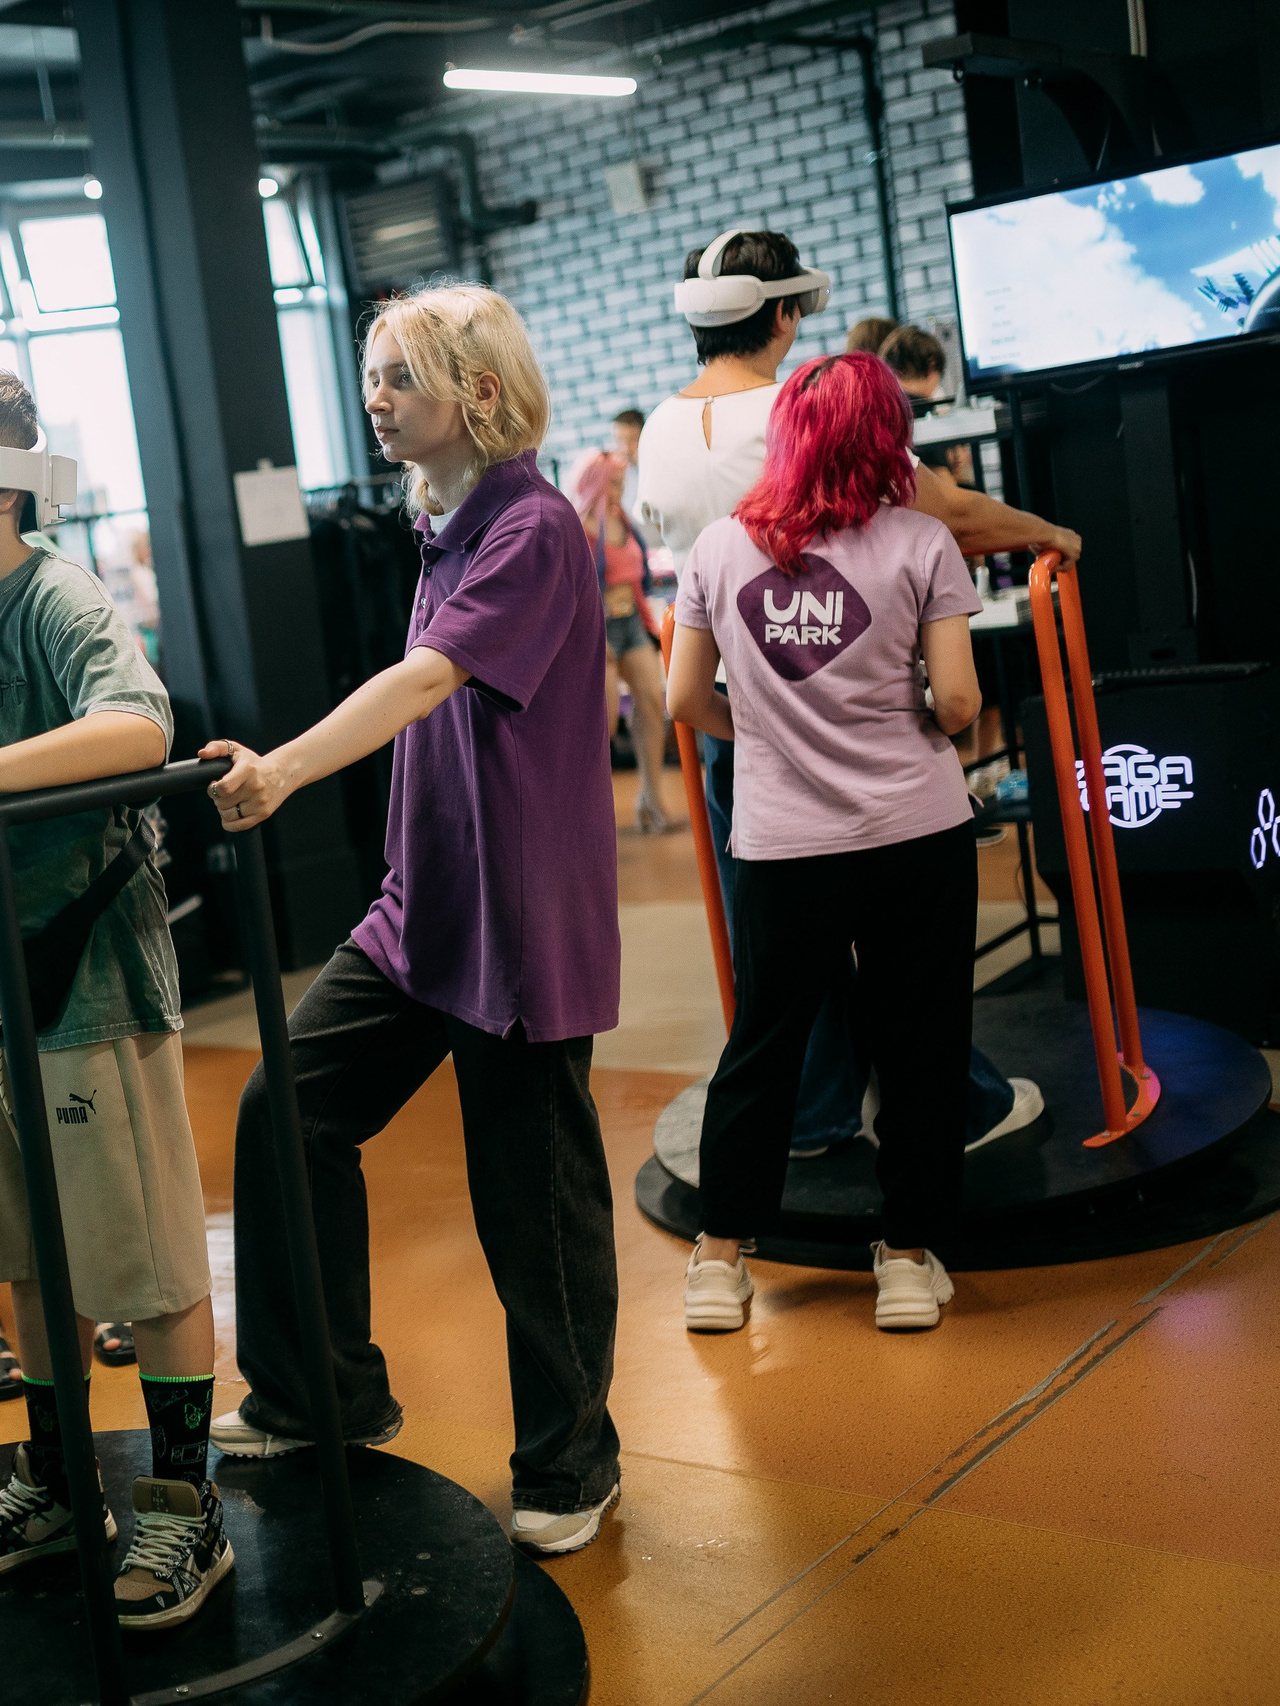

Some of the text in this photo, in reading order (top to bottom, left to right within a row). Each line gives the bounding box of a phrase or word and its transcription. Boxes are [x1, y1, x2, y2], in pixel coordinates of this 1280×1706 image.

[763, 589, 844, 625] UNI
[765, 623, 842, 645] PARK
[56, 1106, 88, 1124] PUMA
